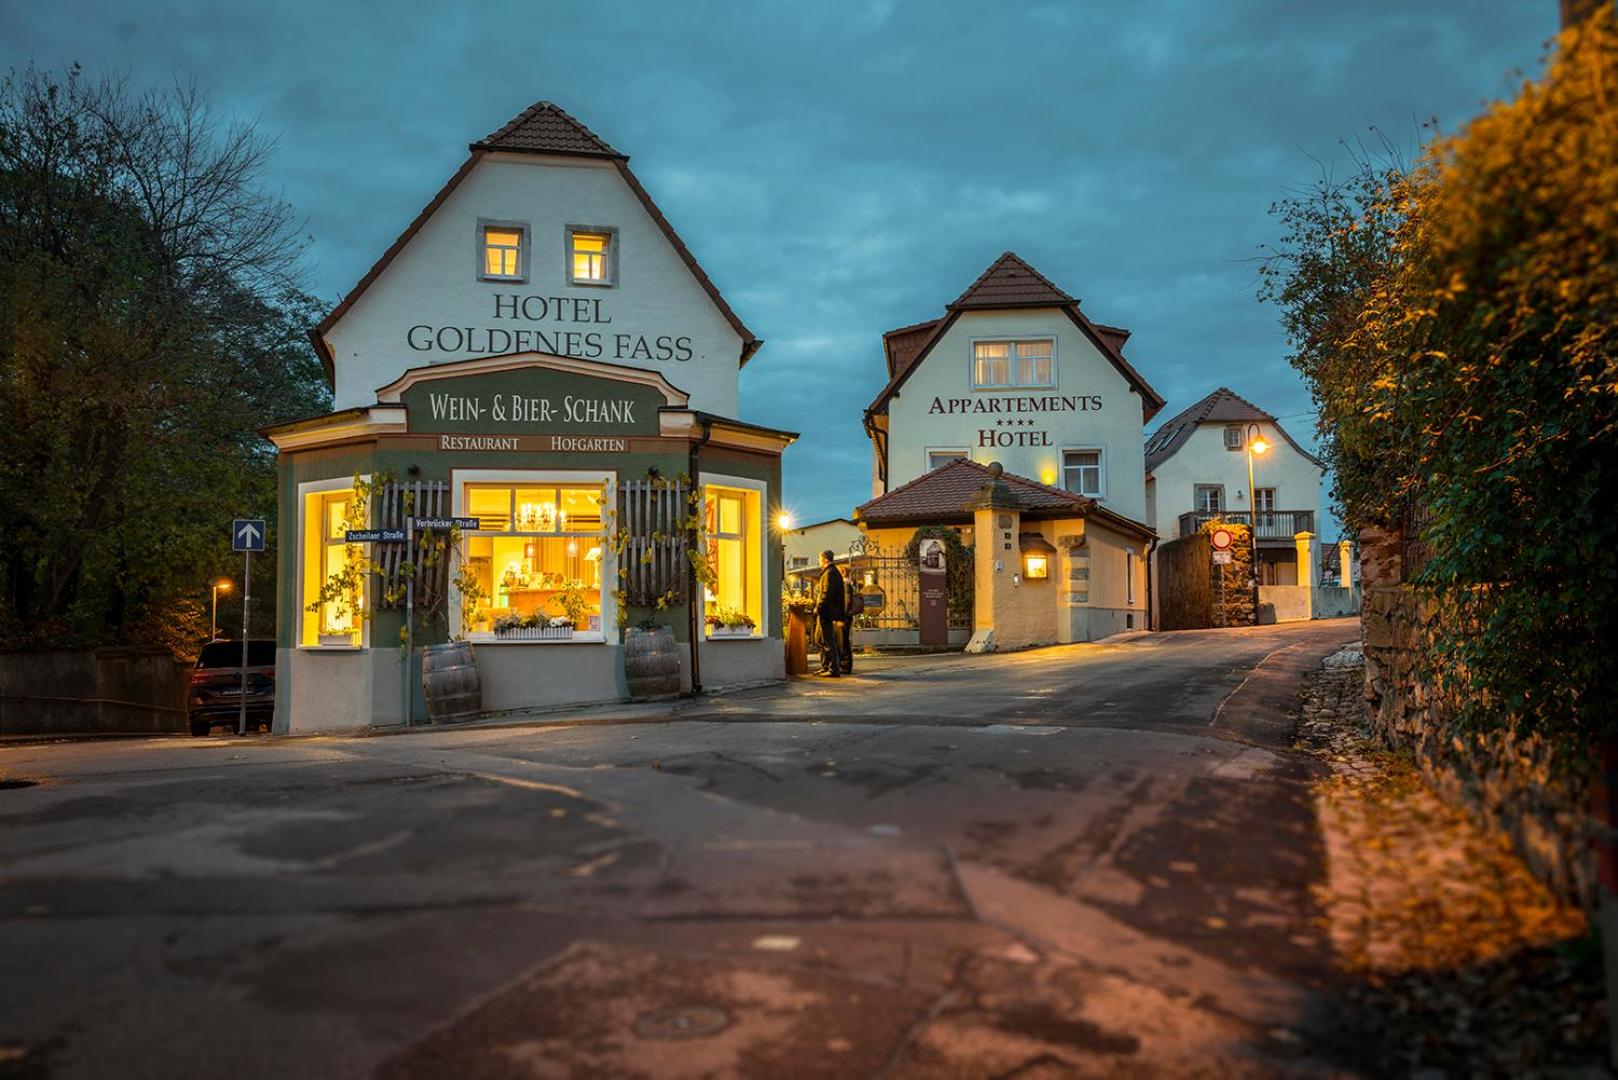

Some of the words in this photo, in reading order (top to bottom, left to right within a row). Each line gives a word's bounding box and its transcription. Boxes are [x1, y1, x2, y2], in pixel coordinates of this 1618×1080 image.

[492, 293, 612, 324] HOTEL
[407, 325, 603, 358] GOLDENES
[613, 333, 693, 362] FASS
[491, 394, 507, 422] &
[563, 395, 636, 424] SCHANK
[928, 395, 1103, 415] APPARTEMENTS
[441, 435, 520, 451] RESTAURANT
[550, 435, 625, 452] HOFGARTEN
[977, 429, 1054, 448] HOTEL
[416, 519, 452, 528] Vorbrücker
[383, 530, 404, 540] Straße
